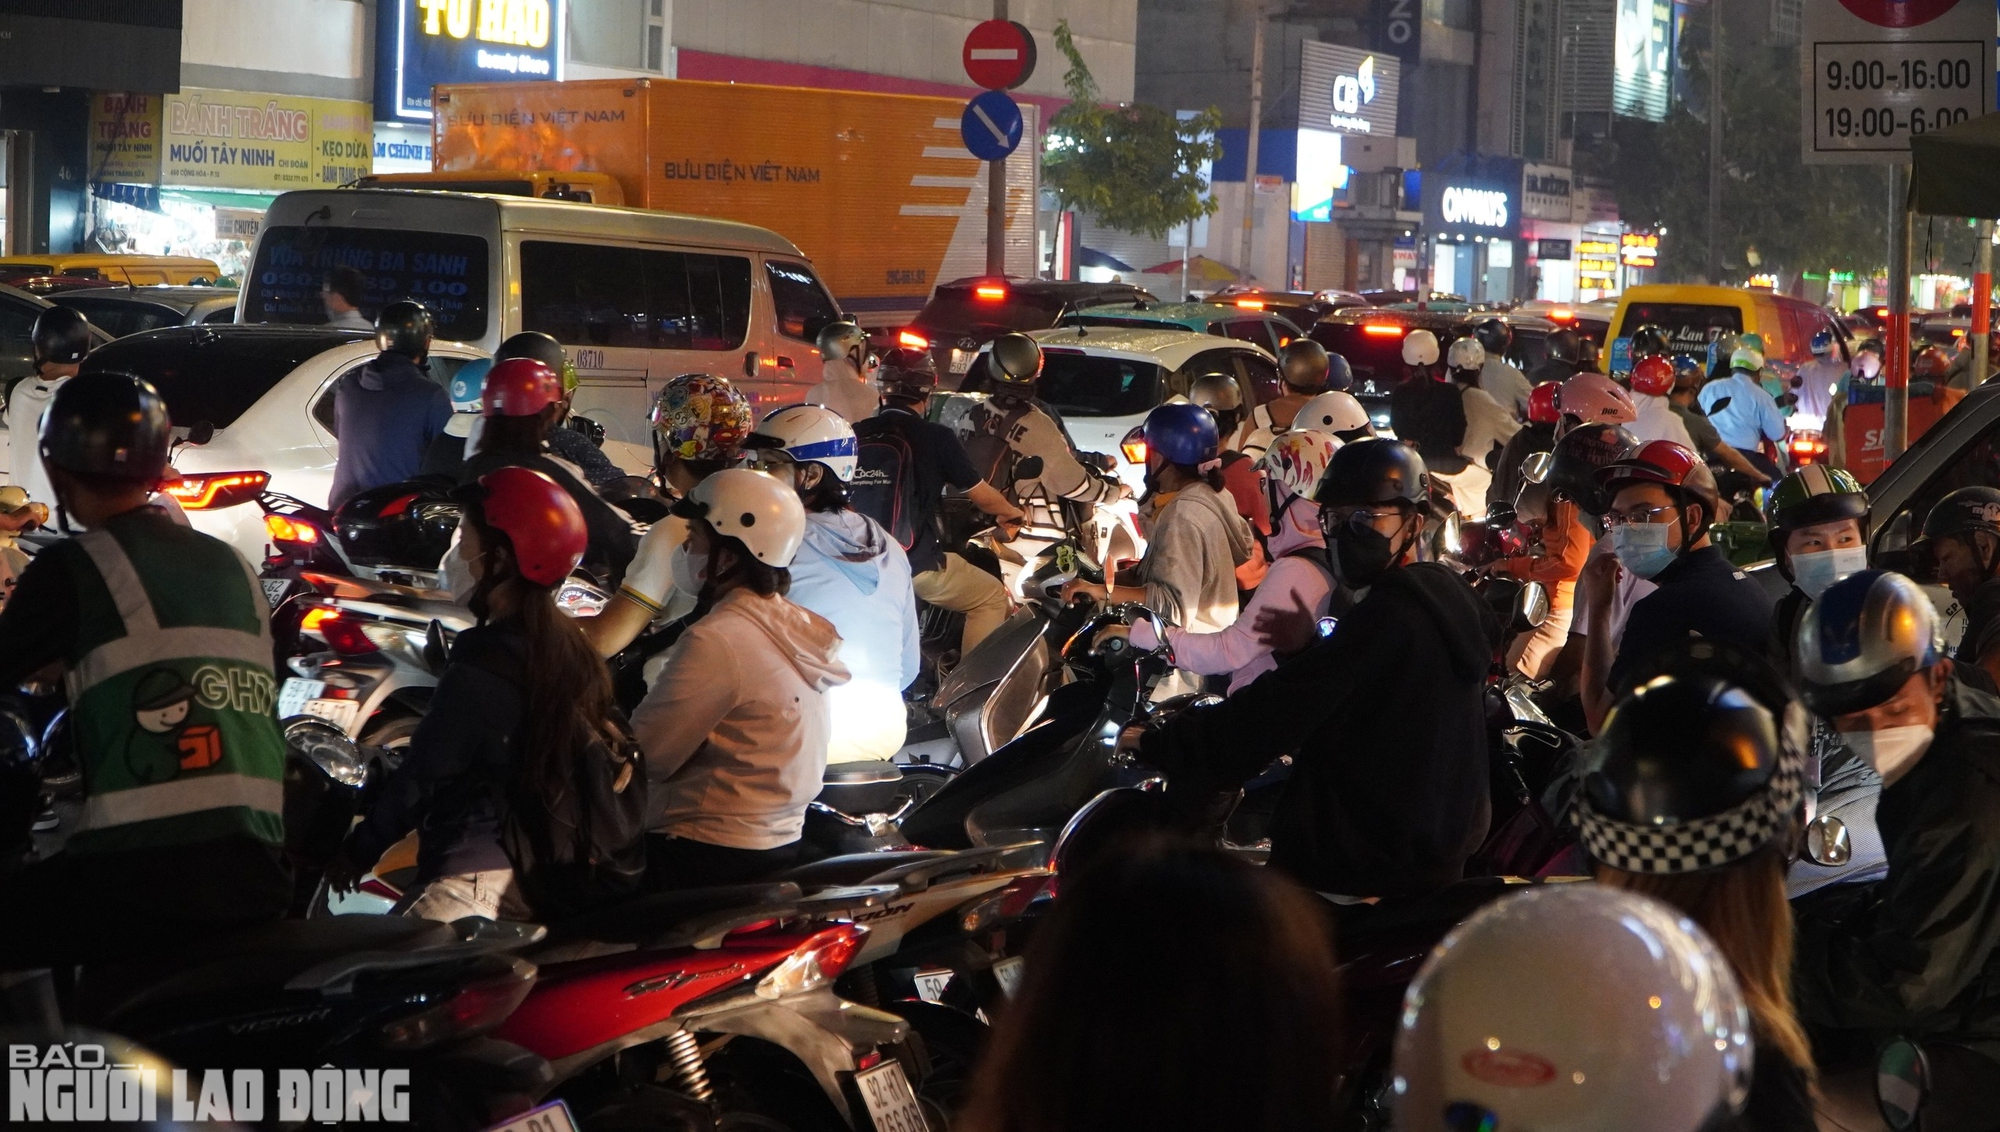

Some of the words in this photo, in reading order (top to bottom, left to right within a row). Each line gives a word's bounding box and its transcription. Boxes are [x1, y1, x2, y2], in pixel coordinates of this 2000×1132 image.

[1826, 59, 1970, 90] 9:00-16:00
[1333, 75, 1359, 113] CB
[170, 95, 233, 138] BÁNH
[235, 101, 309, 143] TRÁNG
[584, 110, 625, 123] NAM
[134, 143, 152, 153] NINH
[170, 140, 208, 164] MUỐI
[211, 142, 237, 165] TÂY
[241, 149, 275, 166] NINH
[322, 140, 343, 162] KẸO
[347, 138, 368, 159] DỪA
[388, 139, 422, 160] CHÍNH
[664, 159, 700, 180] BƯU
[785, 166, 820, 183] NAM
[1442, 187, 1508, 227] ONWAYS
[412, 252, 468, 276] SANH
[410, 280, 468, 296] 100
[1676, 325, 1704, 342] Lan
[576, 349, 604, 369] 03710
